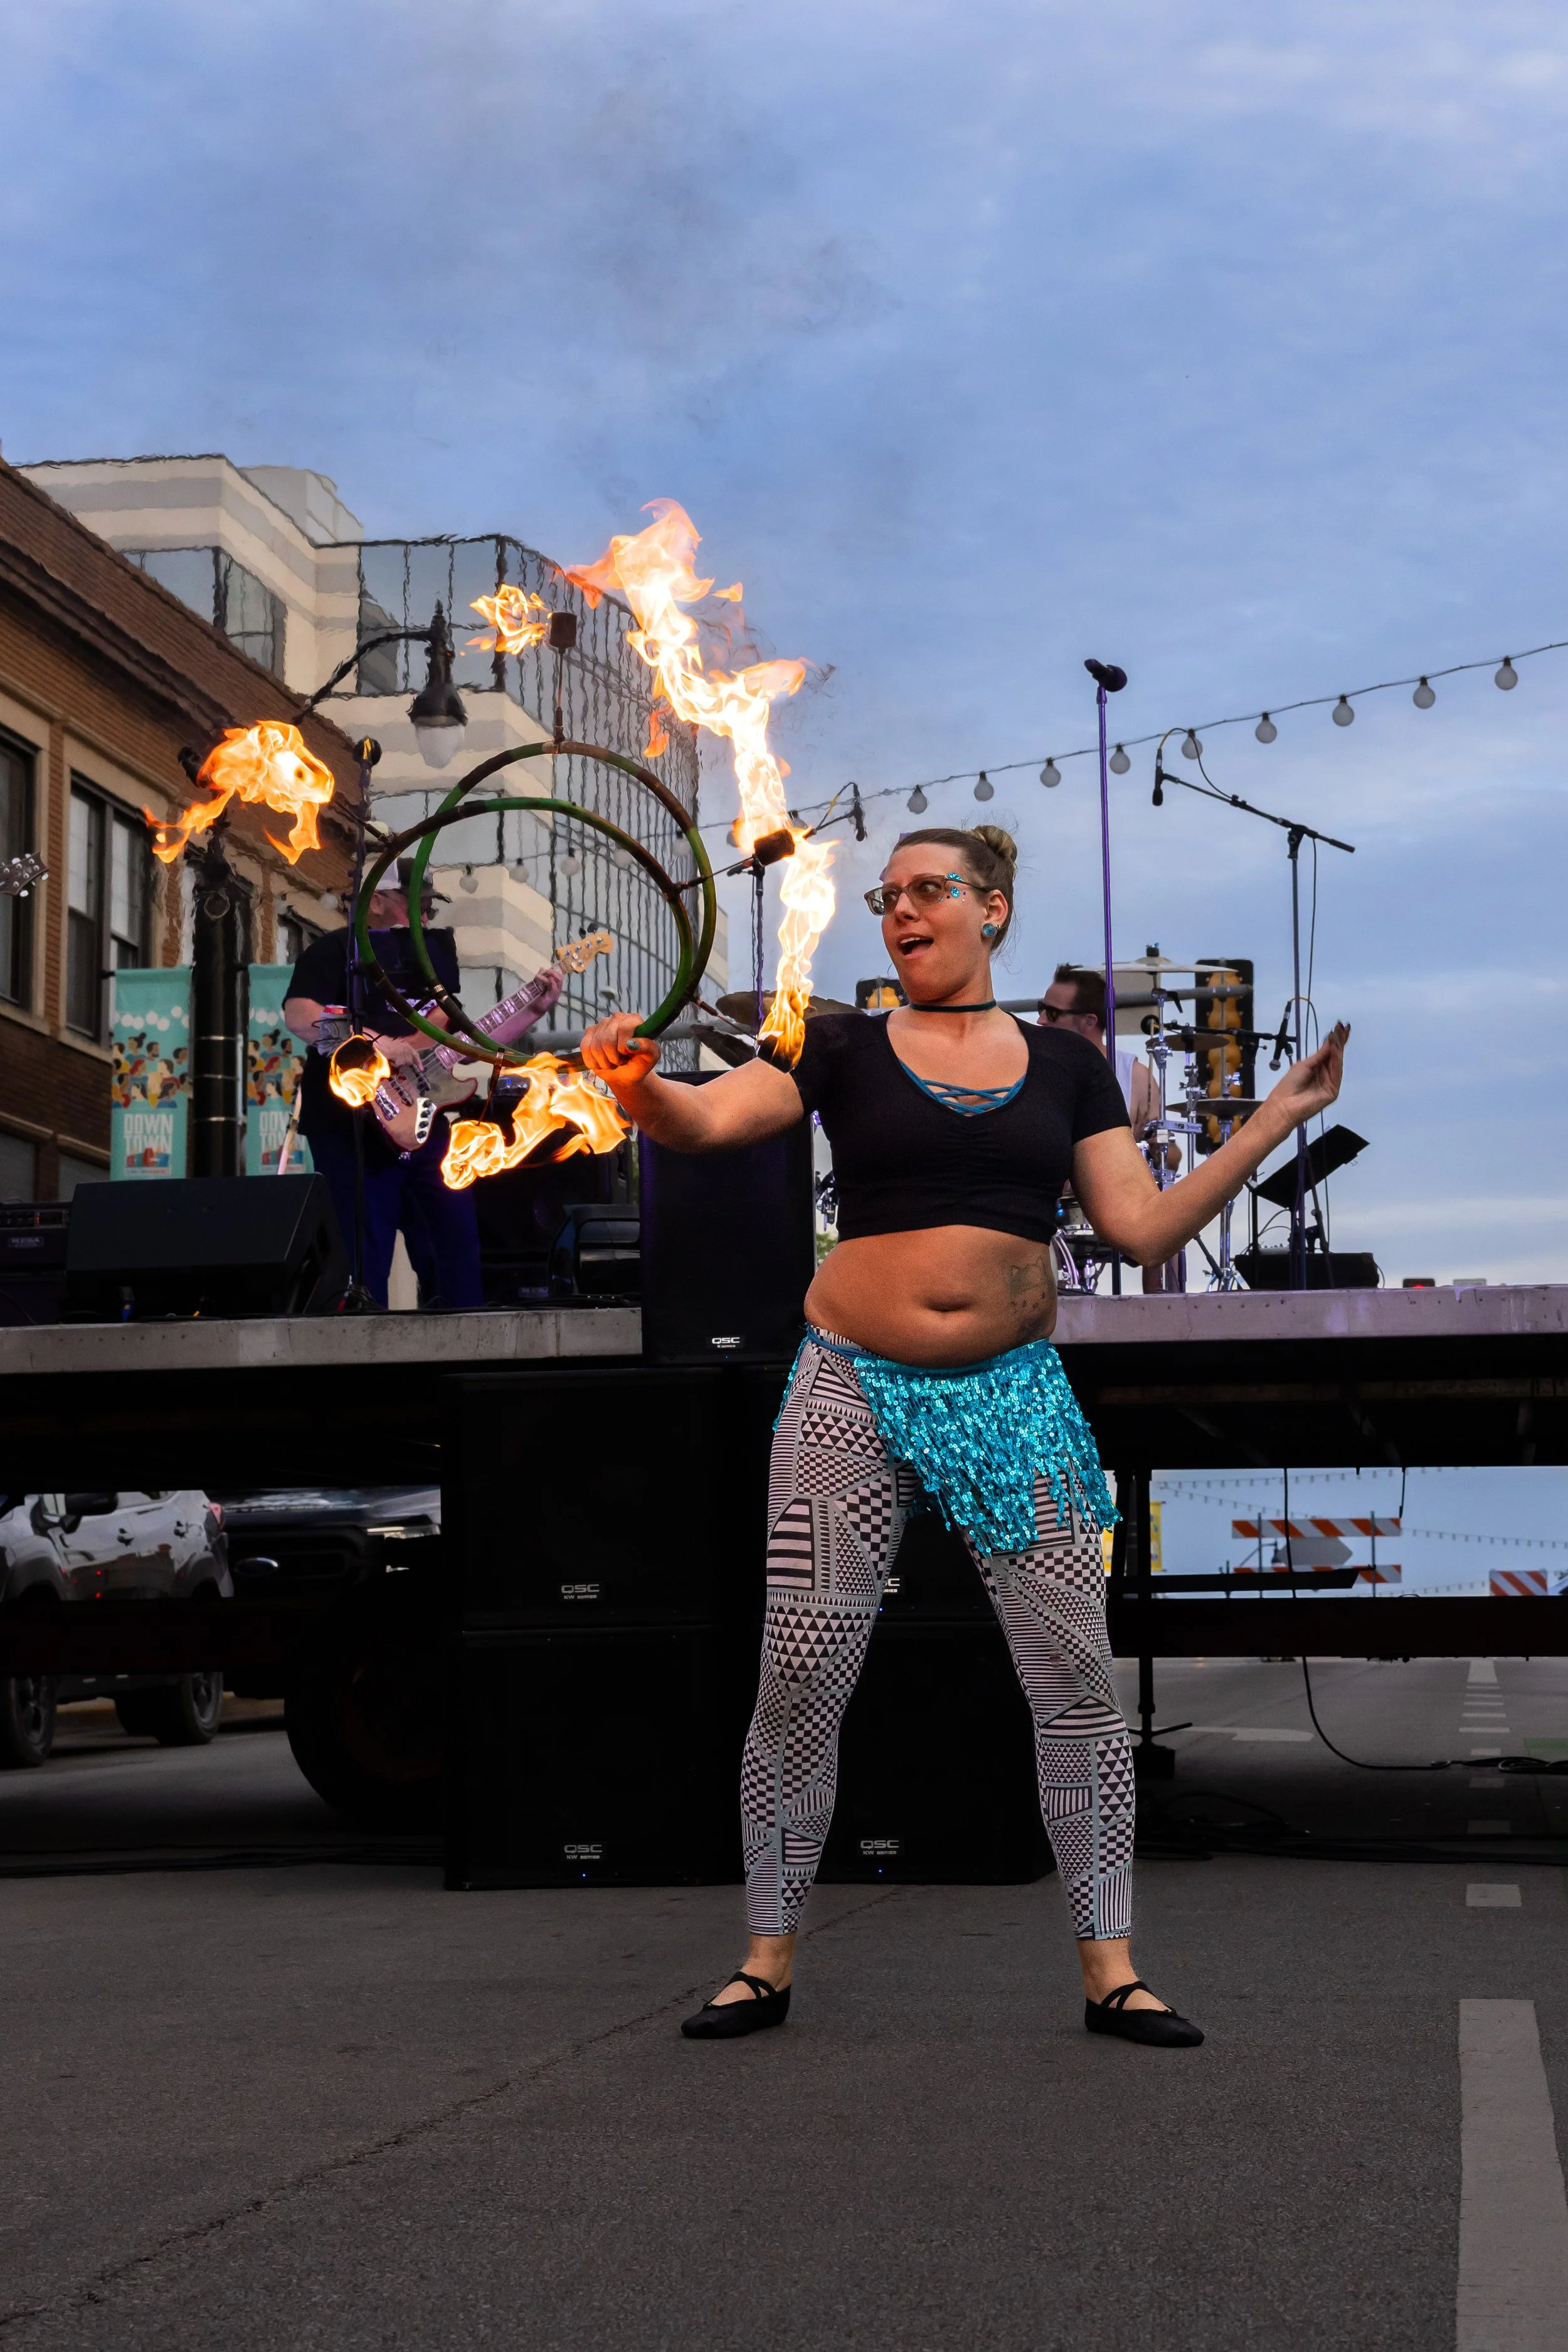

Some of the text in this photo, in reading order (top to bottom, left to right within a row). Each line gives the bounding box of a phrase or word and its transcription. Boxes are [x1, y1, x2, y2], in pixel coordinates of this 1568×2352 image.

[124, 1114, 174, 1134] DOWN
[124, 1134, 172, 1155] TOWN
[561, 1583, 600, 1594] QSC
[564, 1844, 603, 1853] QSC
[860, 1839, 899, 1849] QSC
